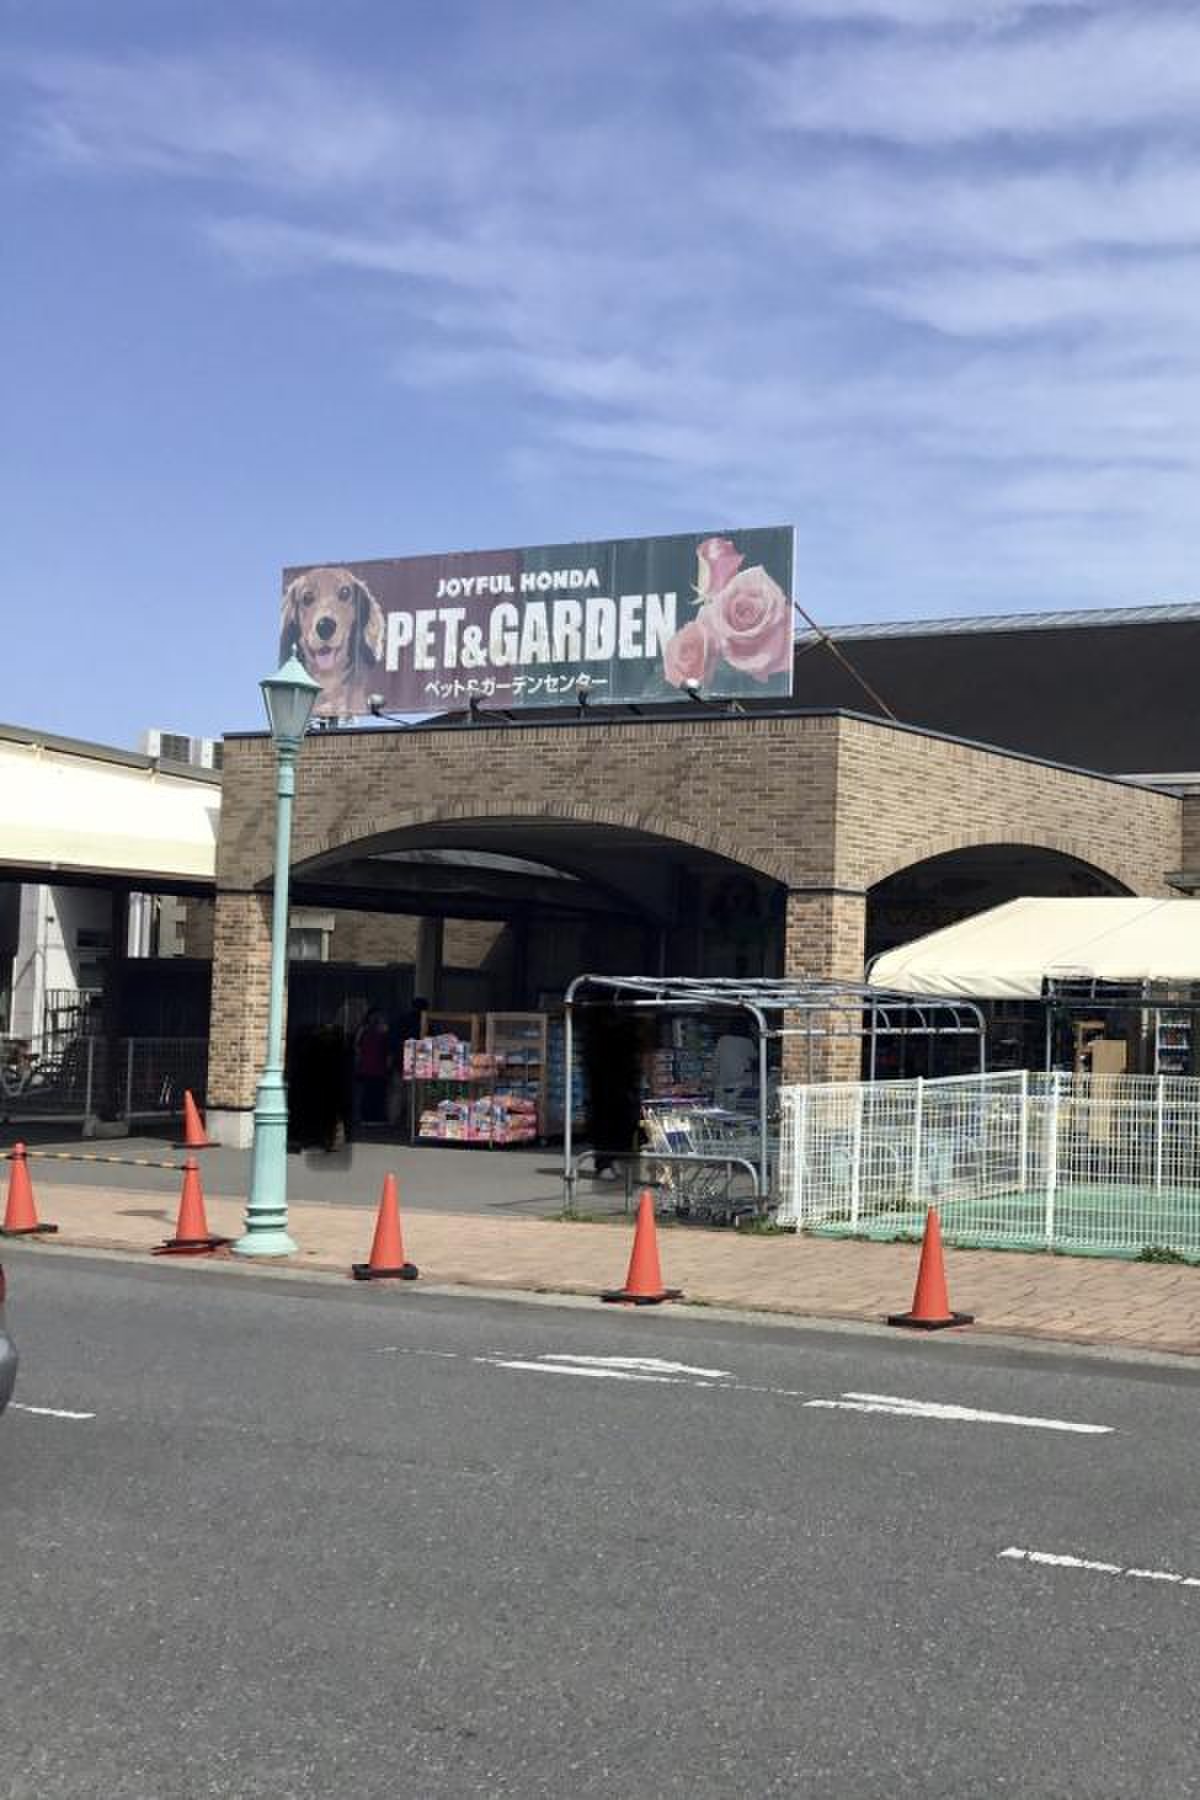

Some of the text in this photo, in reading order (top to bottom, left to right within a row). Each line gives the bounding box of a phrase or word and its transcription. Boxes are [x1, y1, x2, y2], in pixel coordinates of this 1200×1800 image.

[437, 568, 600, 598] JOYFUL HONDA
[385, 591, 678, 672] PET&GARDEN
